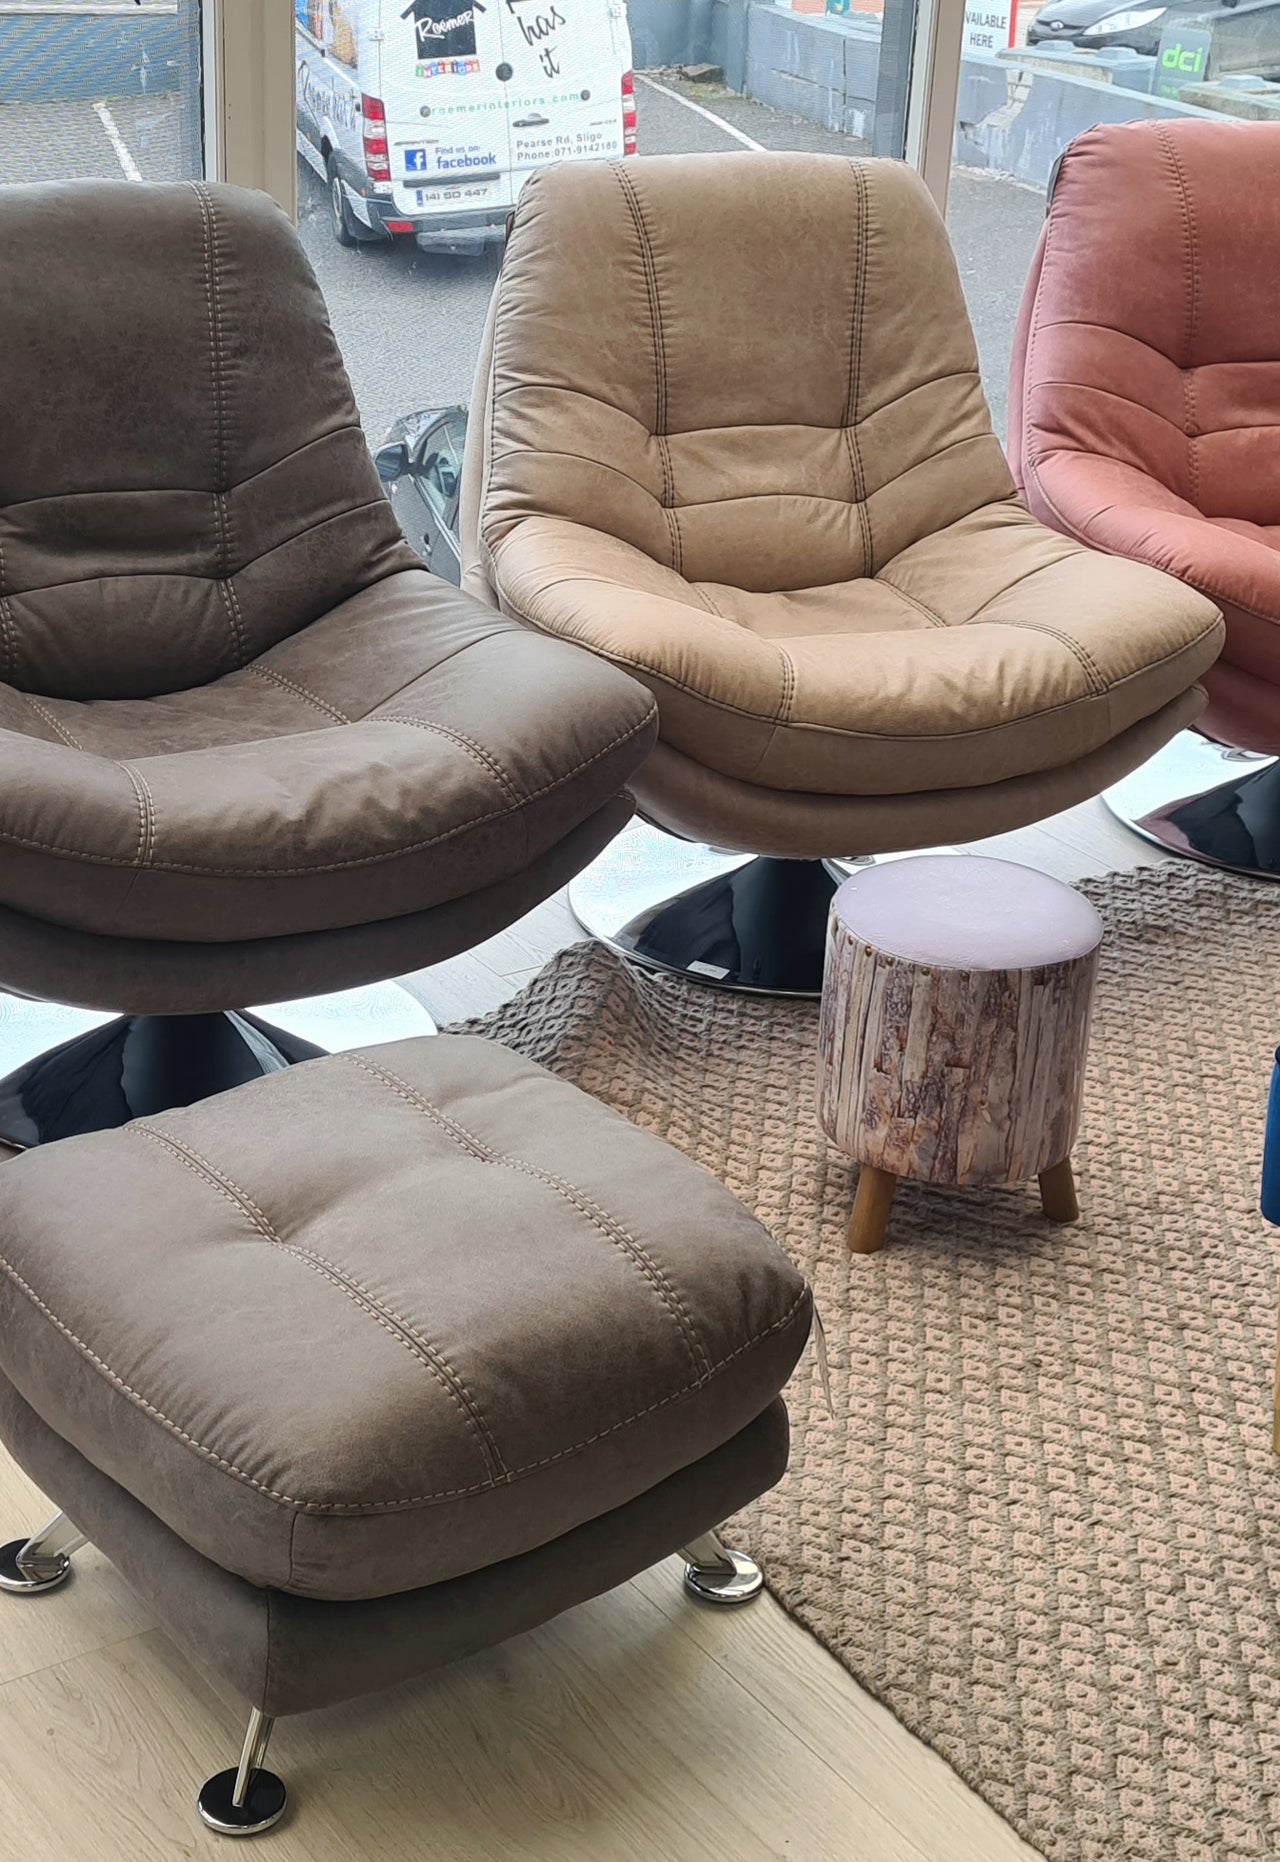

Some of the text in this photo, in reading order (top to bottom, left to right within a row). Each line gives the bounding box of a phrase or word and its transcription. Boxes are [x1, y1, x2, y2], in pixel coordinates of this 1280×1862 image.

[415, 10, 474, 42] Roemer
[517, 6, 566, 46] has
[965, 11, 1007, 29] VAILABLE
[970, 32, 993, 48] HERE
[539, 46, 560, 78] it
[1162, 43, 1204, 72] dci
[517, 139, 553, 149] Pearse
[576, 132, 602, 143] Sligo
[435, 146, 454, 156] Find
[436, 151, 497, 170] facebook
